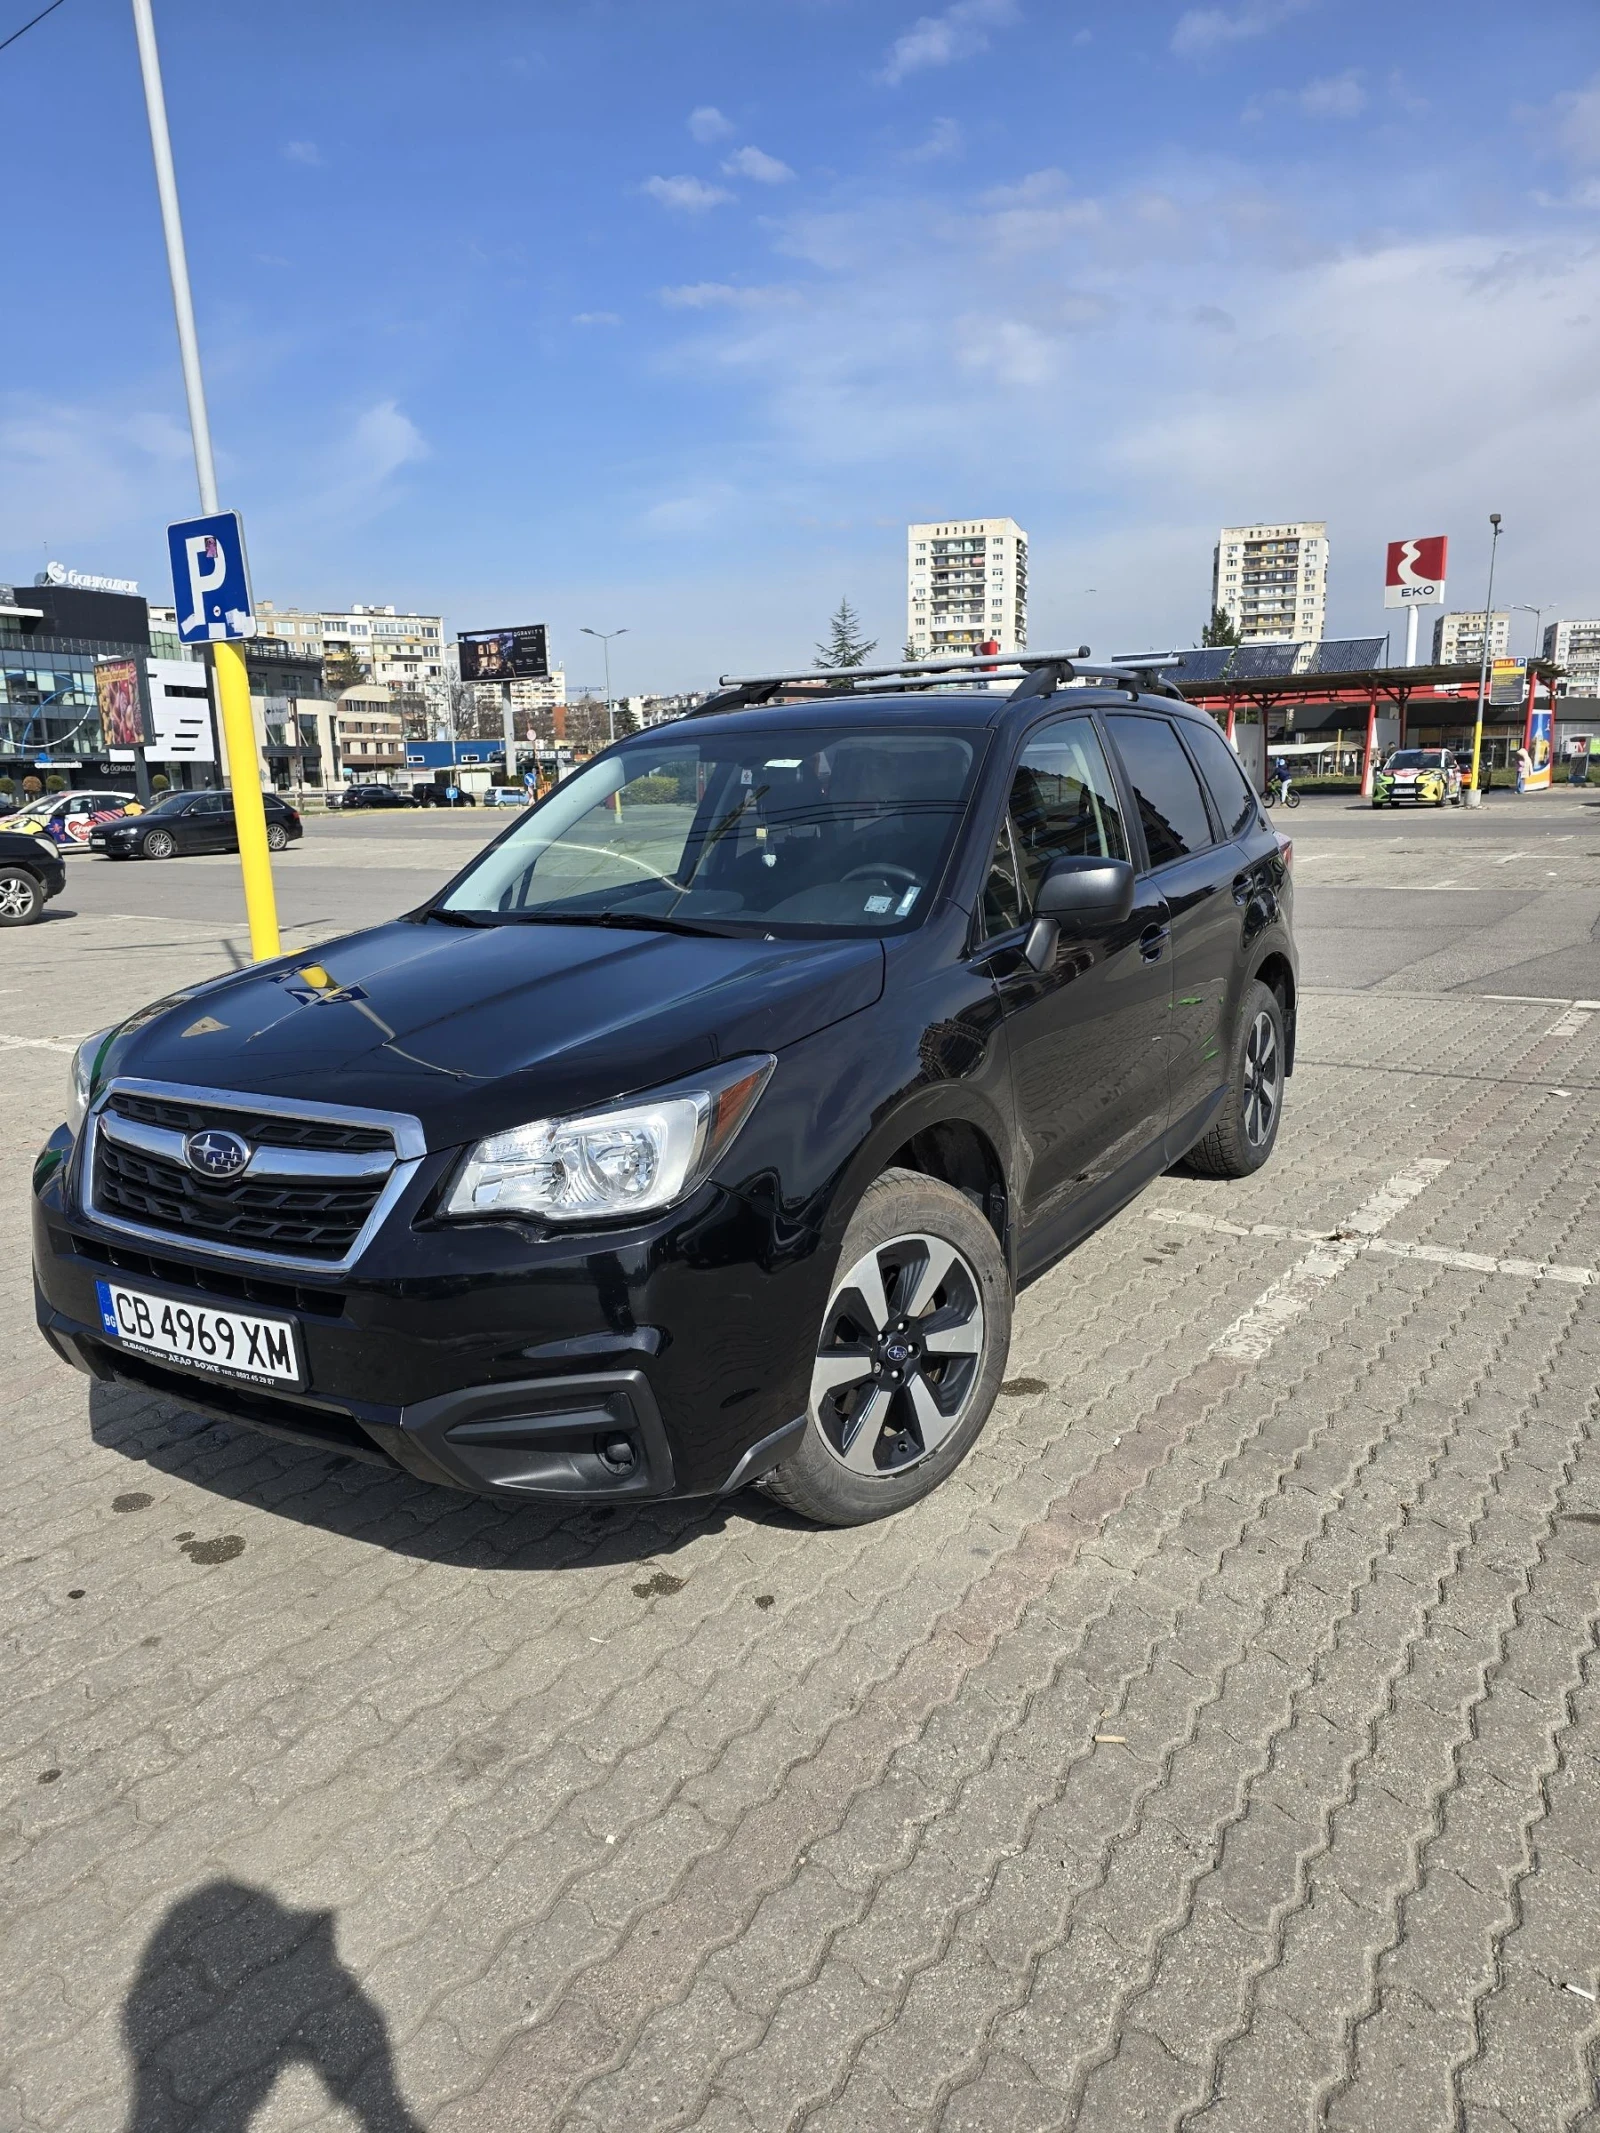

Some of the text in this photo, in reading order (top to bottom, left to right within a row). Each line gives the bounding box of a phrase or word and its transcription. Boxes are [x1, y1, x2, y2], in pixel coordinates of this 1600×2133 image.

[185, 535, 227, 626] P
[1401, 585, 1435, 598] EKO
[557, 751, 572, 759] BOX
[104, 1313, 117, 1328] BG
[121, 1340, 149, 1354] SUBARU
[168, 1353, 192, 1366] ДЕДО
